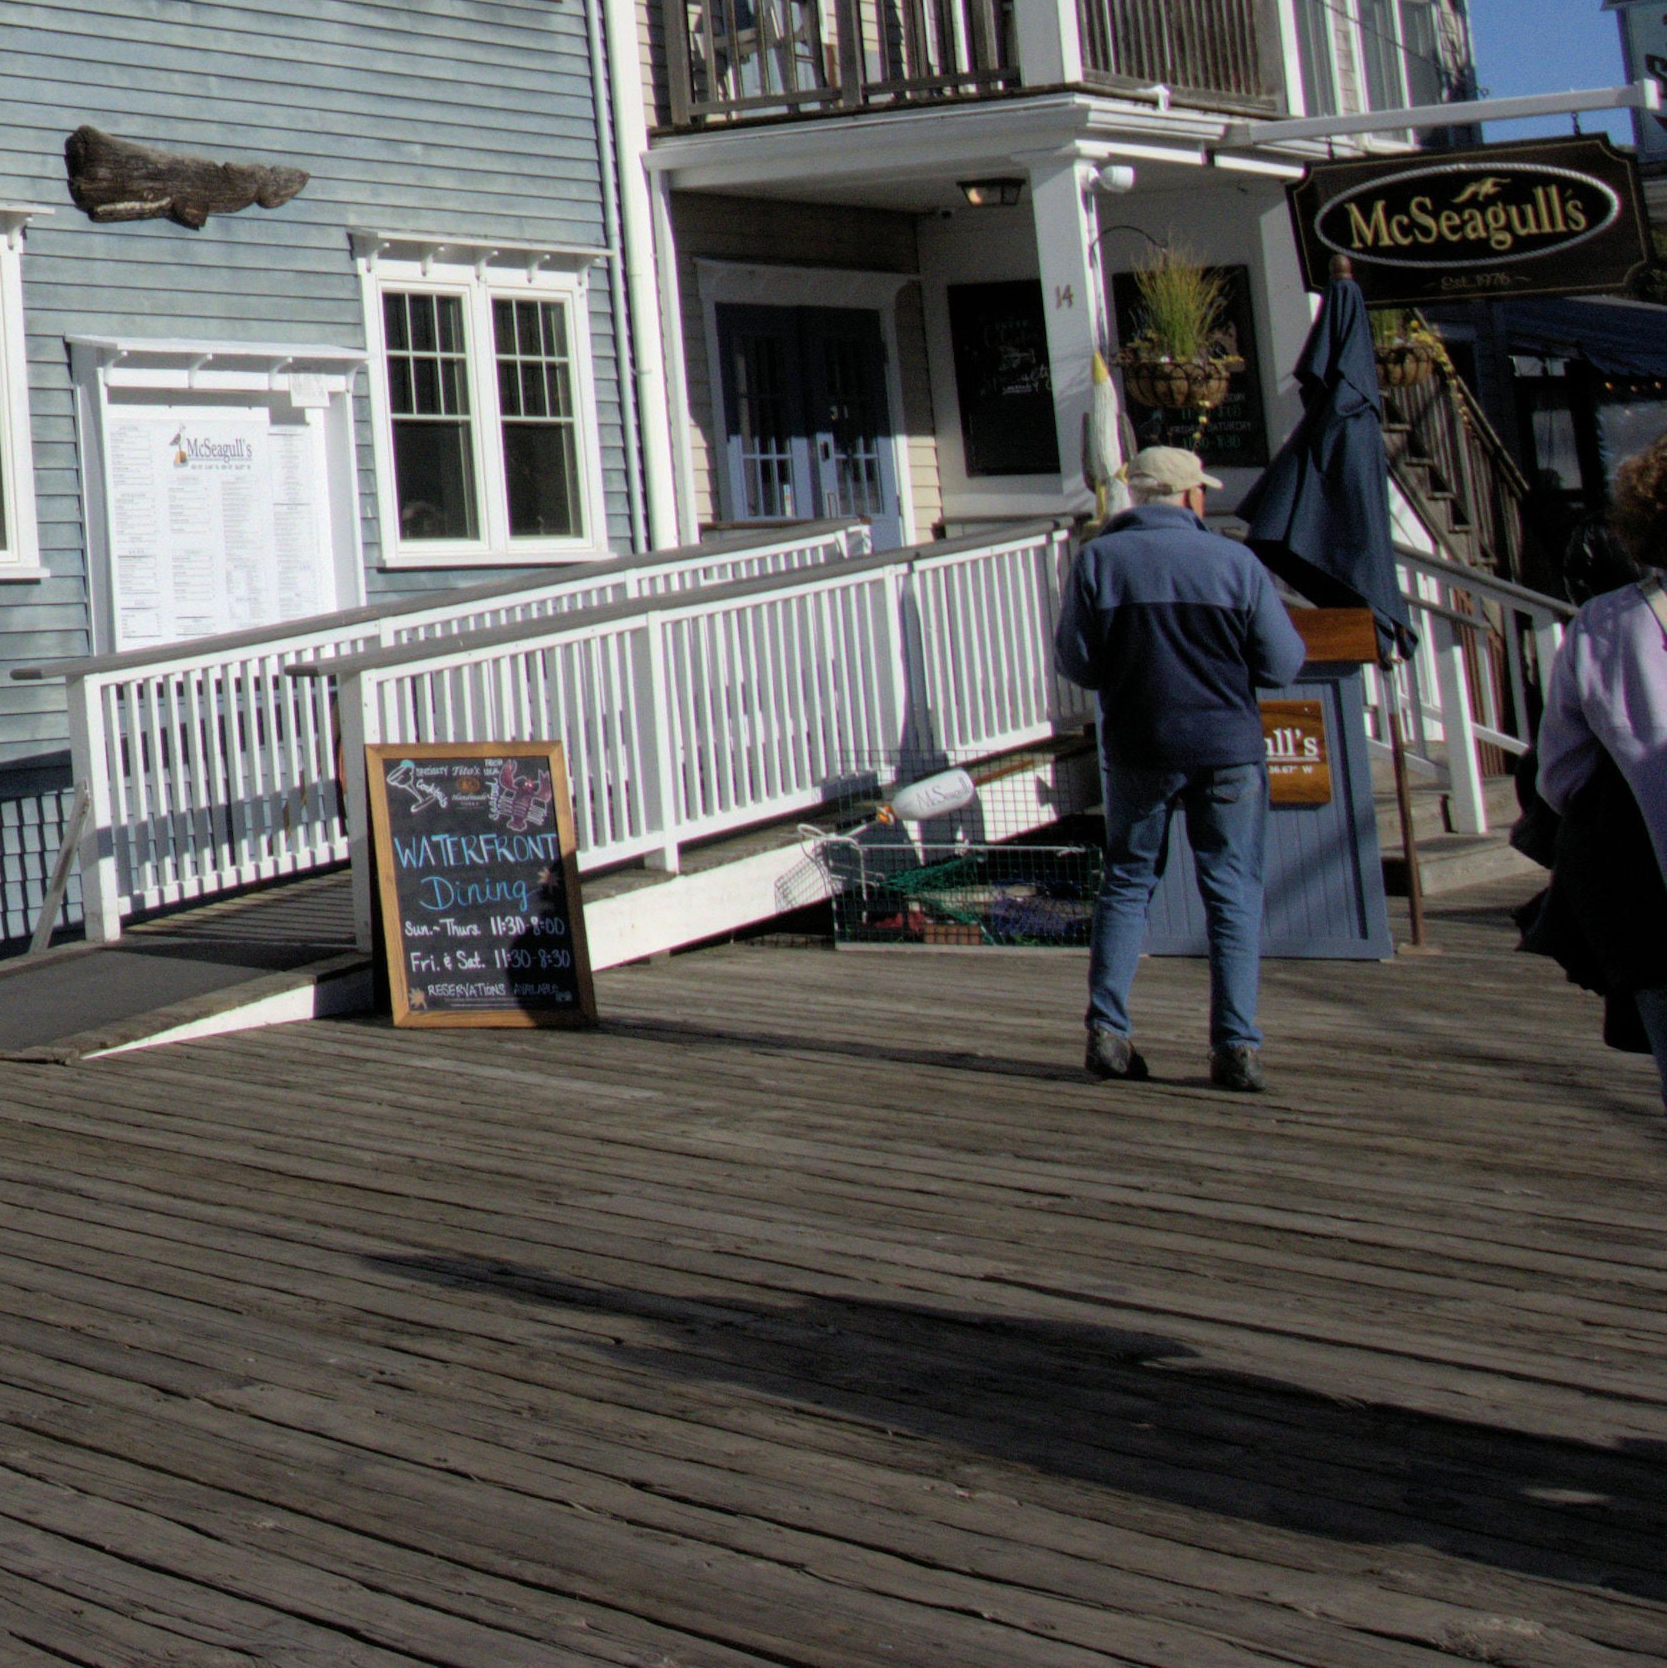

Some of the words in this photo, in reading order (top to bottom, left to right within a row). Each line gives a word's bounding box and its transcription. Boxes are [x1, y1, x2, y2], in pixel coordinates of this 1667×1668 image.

[1344, 184, 1588, 251] McSeagull's
[1054, 284, 1074, 309] 14
[186, 438, 252, 463] McSeagull's
[452, 765, 480, 776] Tito's
[394, 833, 557, 869] WATERFRONT
[419, 875, 533, 912] Dining
[410, 952, 440, 973] Fri.
[457, 950, 485, 970] Sat.
